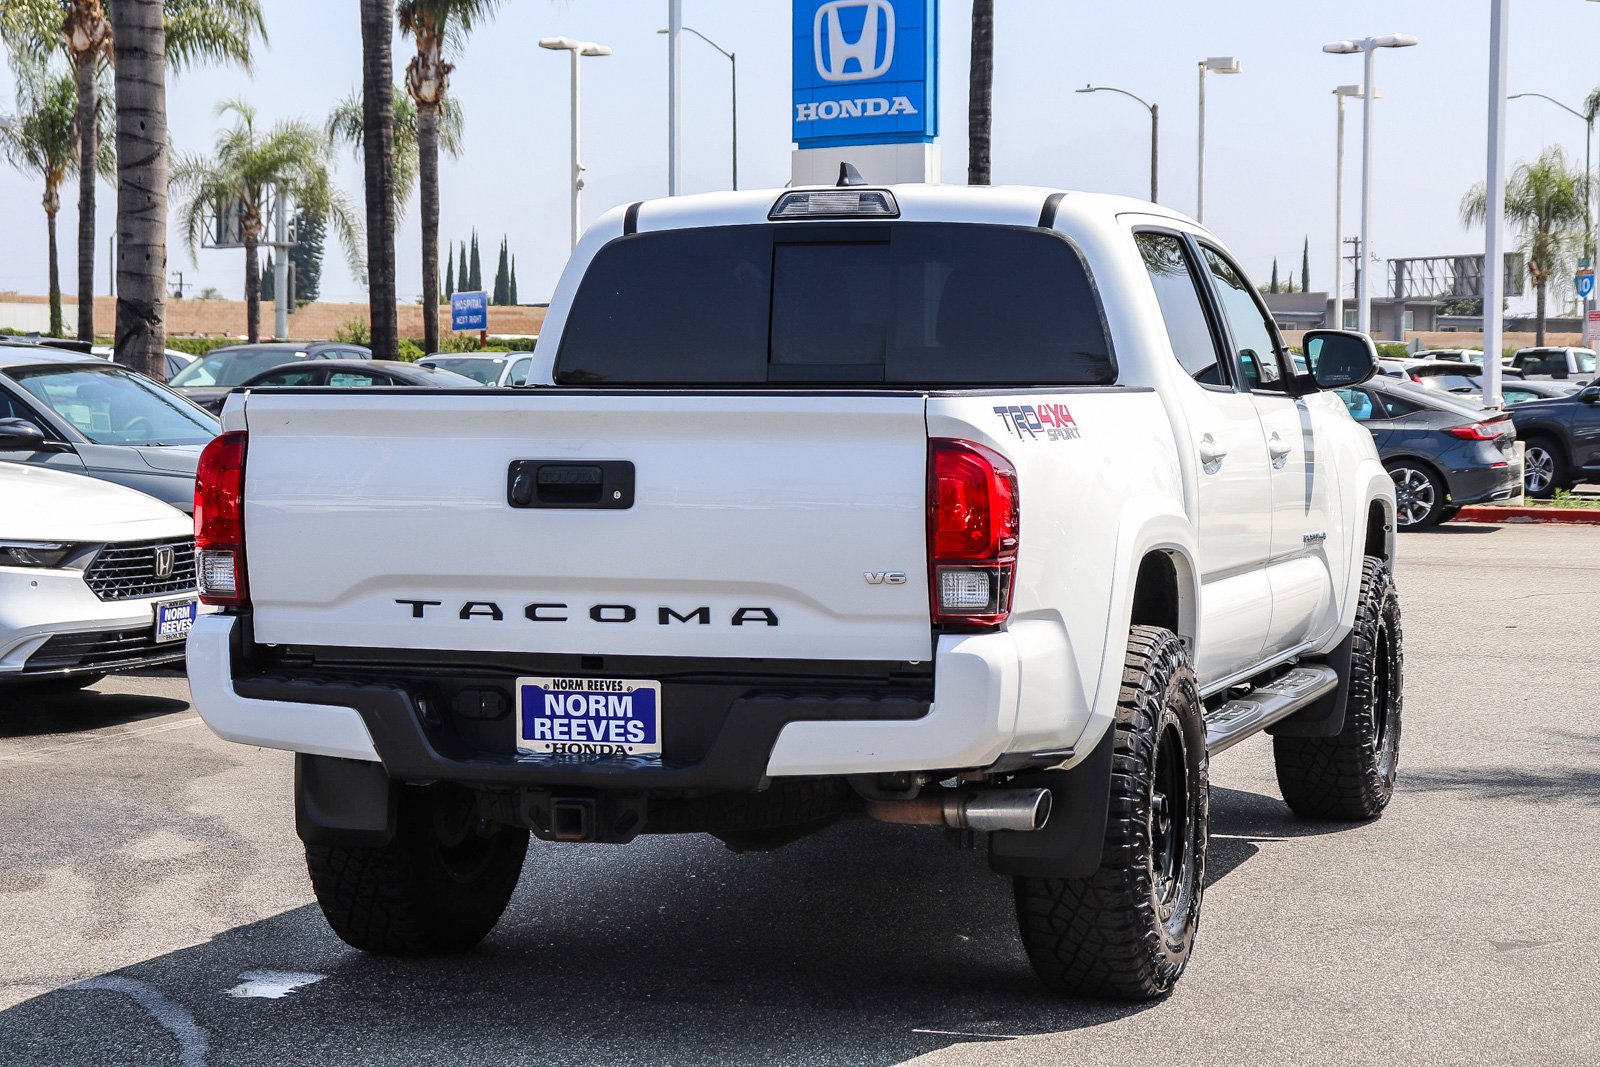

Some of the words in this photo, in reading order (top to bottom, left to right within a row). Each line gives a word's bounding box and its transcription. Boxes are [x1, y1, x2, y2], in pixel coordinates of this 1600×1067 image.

[796, 96, 918, 122] HONDA
[455, 298, 483, 310] HOSPITAL
[992, 405, 1044, 441] TRD
[1046, 427, 1081, 442] SPORT
[864, 572, 906, 584] V6
[164, 606, 190, 621] NORM
[395, 599, 779, 627] TACOMA
[160, 618, 192, 634] REEVES
[552, 679, 584, 691] NORM
[587, 680, 623, 692] REEVES
[544, 694, 633, 718] NORM
[534, 718, 645, 742] REEVES
[552, 743, 628, 755] HONDA
